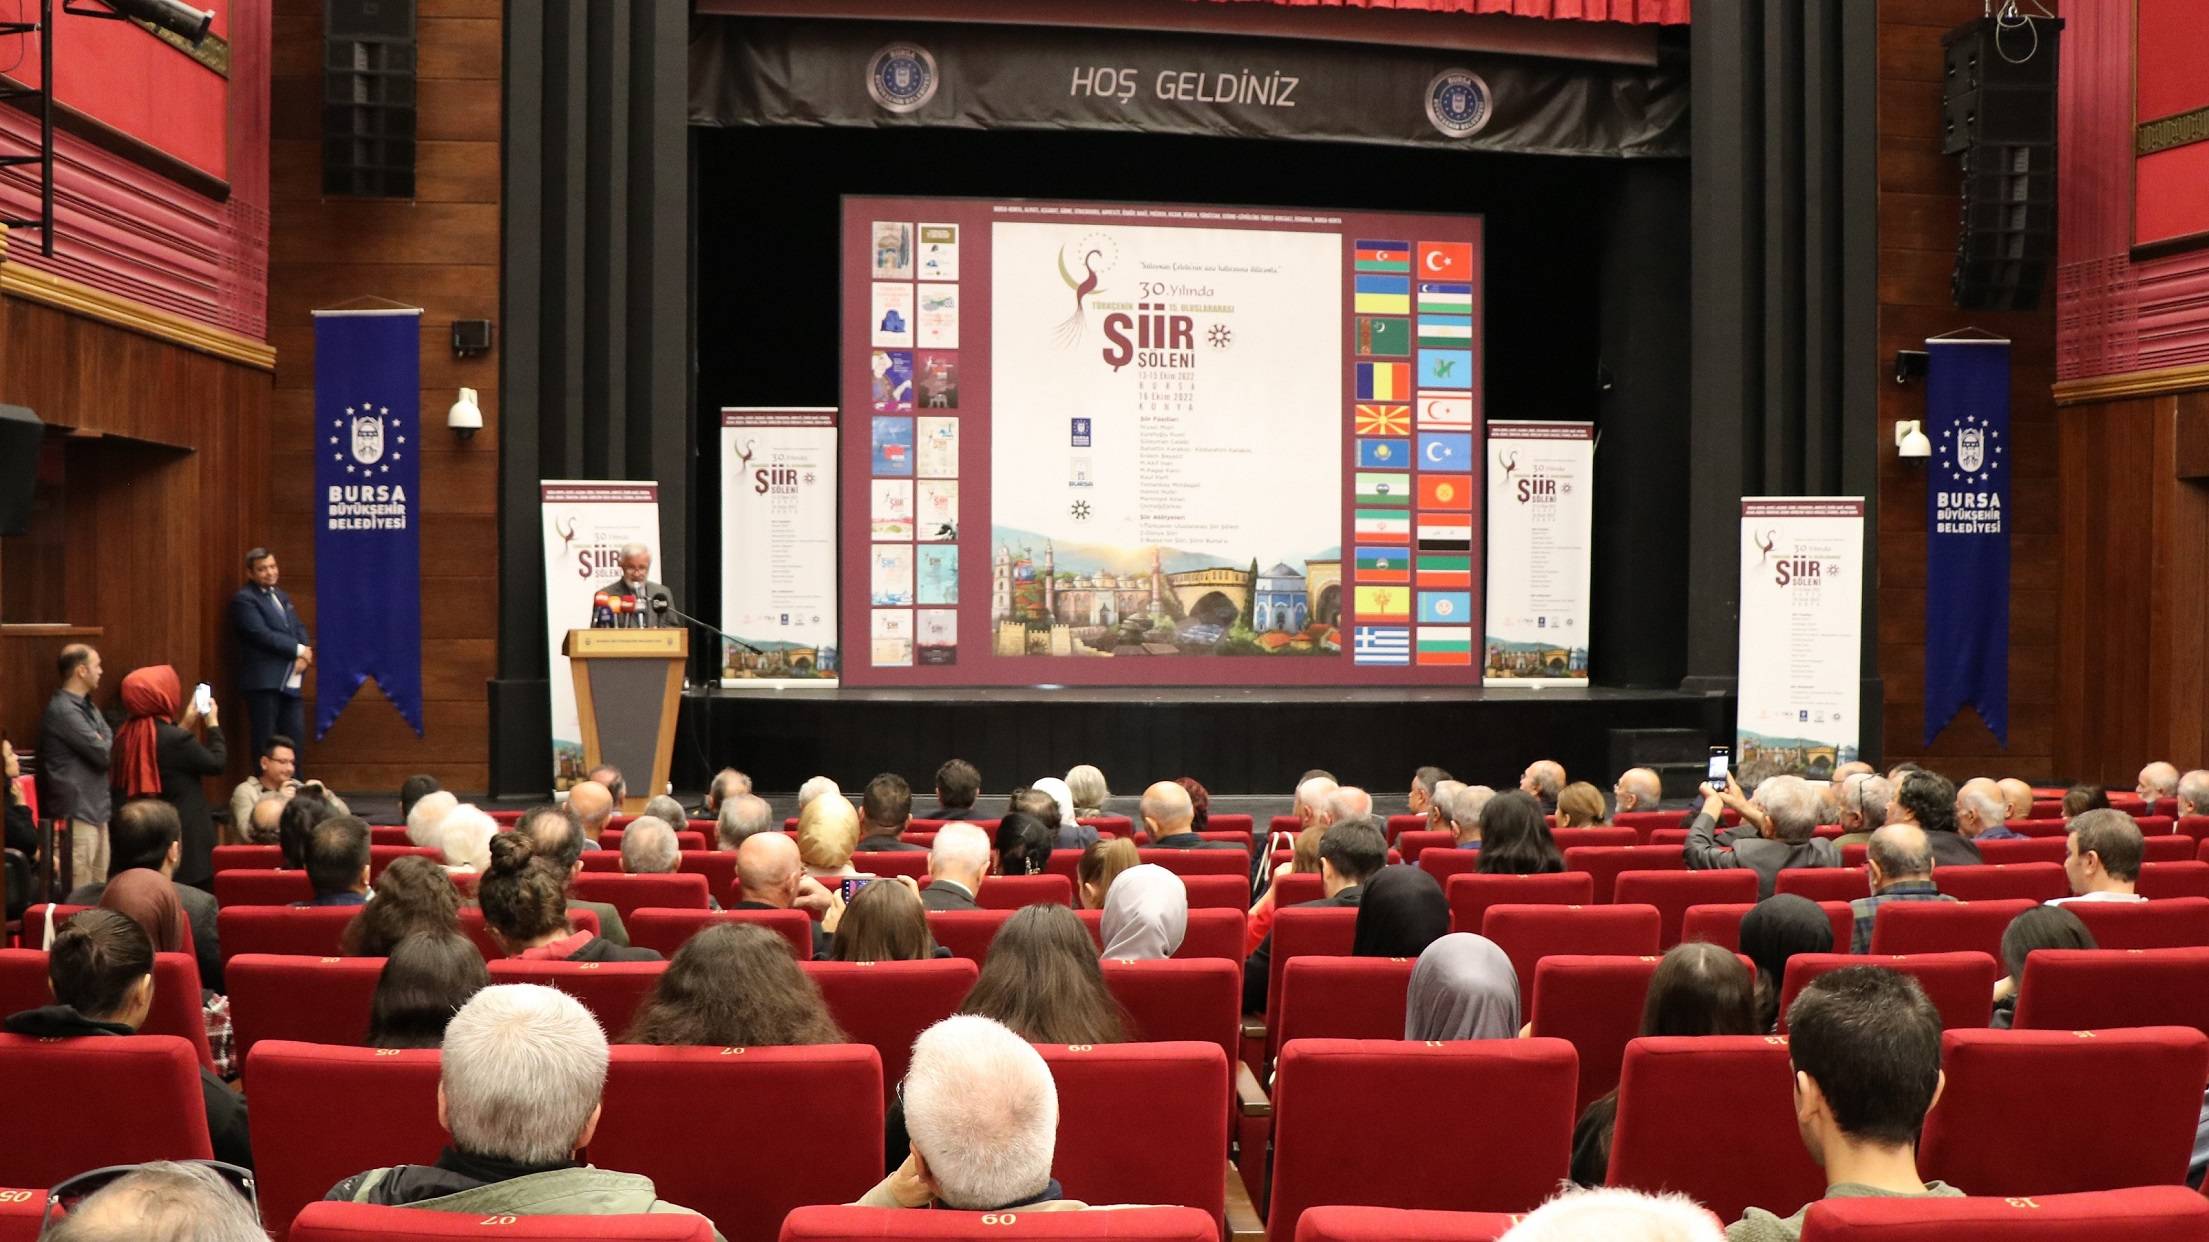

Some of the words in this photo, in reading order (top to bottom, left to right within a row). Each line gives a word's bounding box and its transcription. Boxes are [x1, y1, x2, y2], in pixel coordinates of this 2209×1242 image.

[1070, 67, 1138, 104] HOŞ
[1155, 68, 1299, 107] GELDİNİZ
[328, 485, 406, 502] BURSA
[1937, 492, 2001, 508] BURSA
[328, 502, 406, 516] BÜYÜKŞEHİR
[1937, 507, 2001, 521] BÜYÜKŞEHİR
[328, 515, 407, 529] BELEDİYESİ
[1937, 520, 2001, 533] BELEDİYESİ
[480, 1216, 517, 1225] 07
